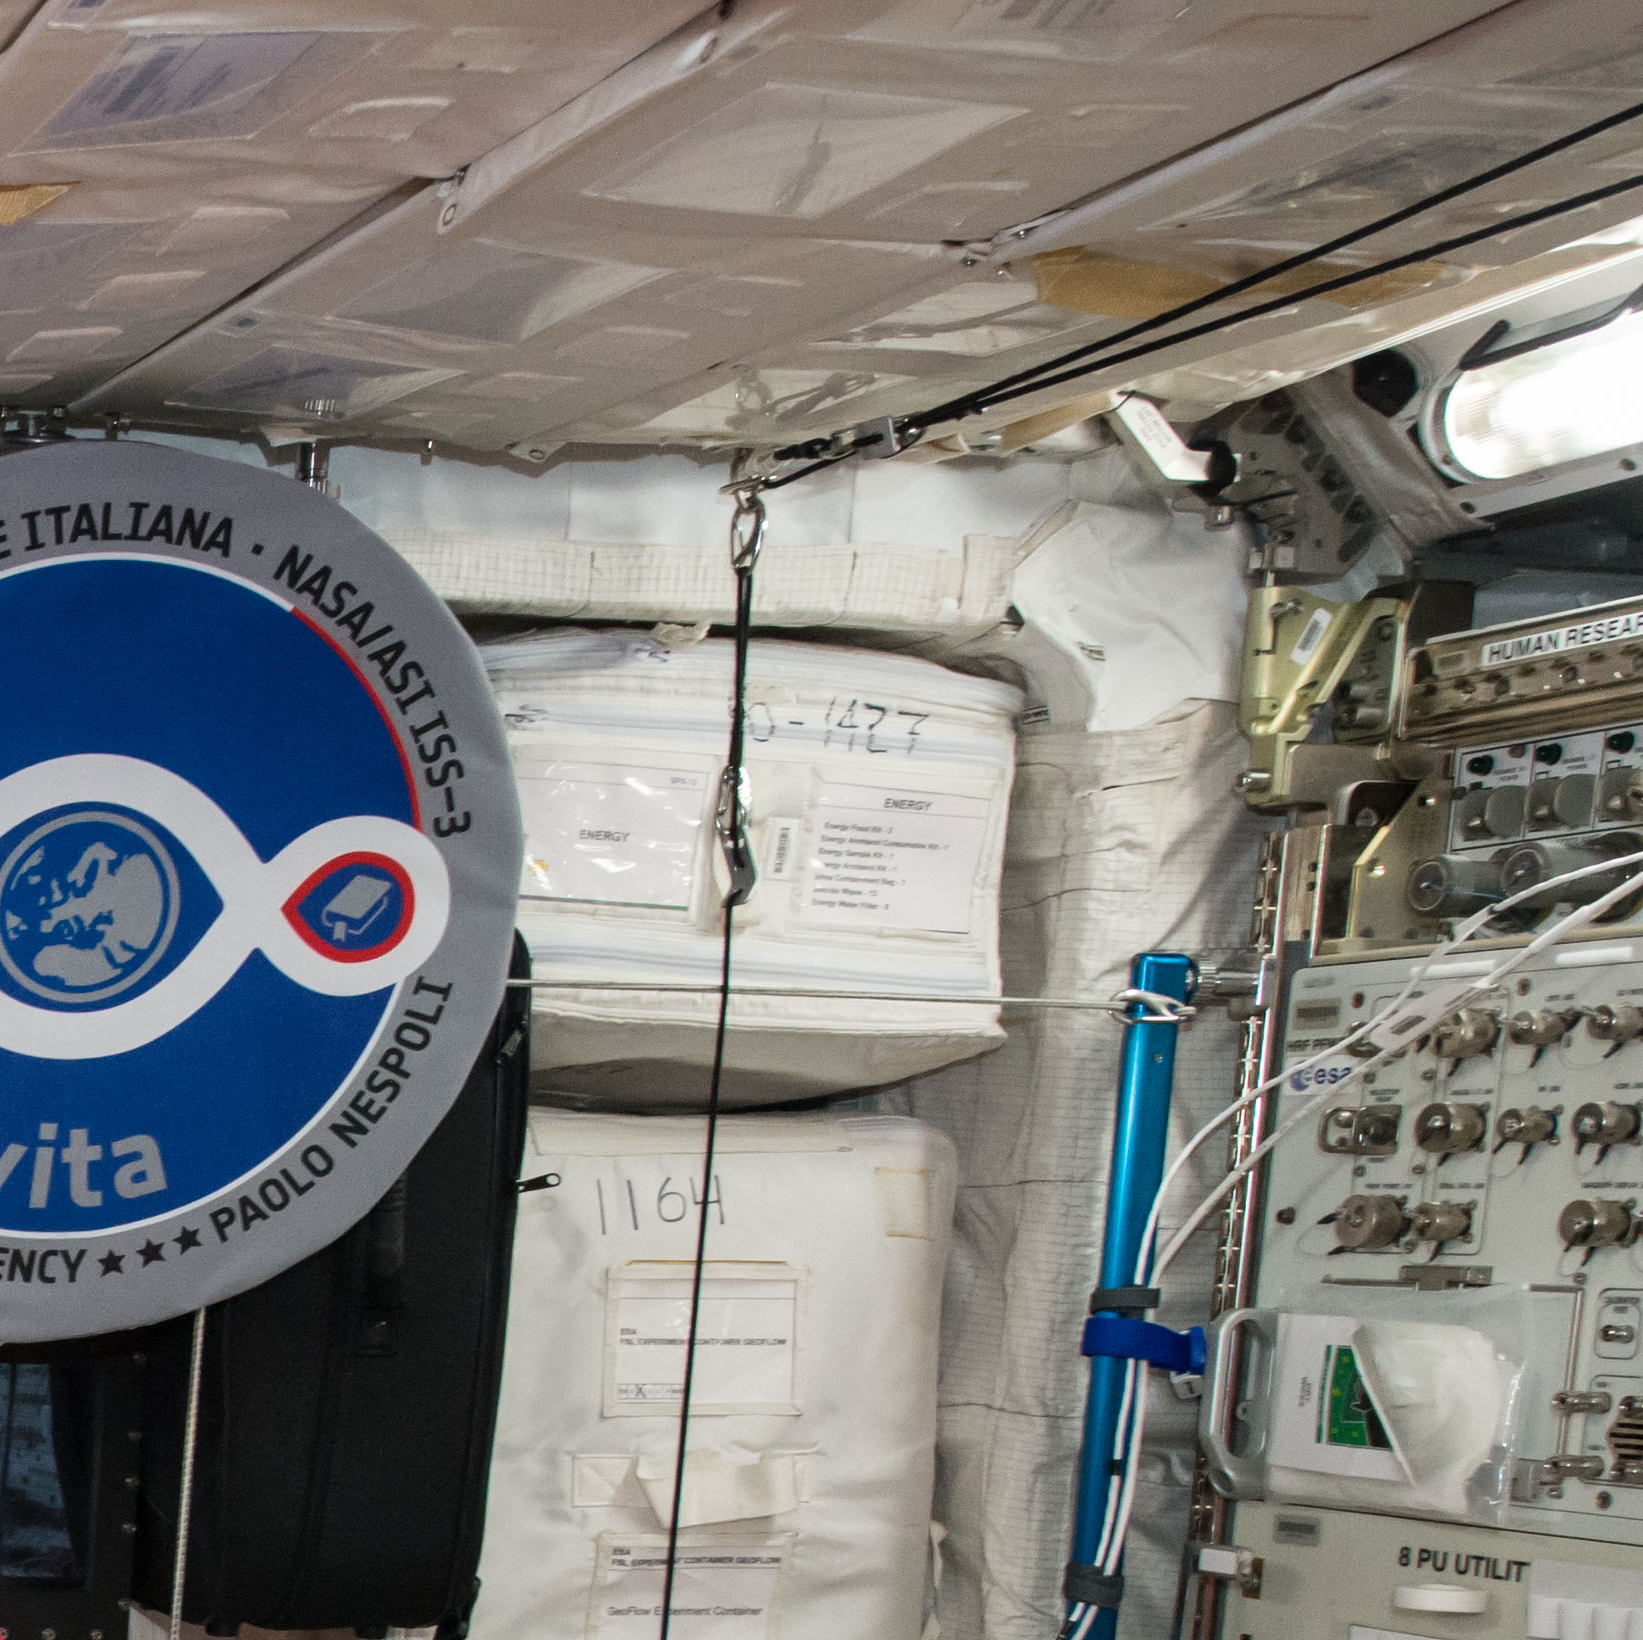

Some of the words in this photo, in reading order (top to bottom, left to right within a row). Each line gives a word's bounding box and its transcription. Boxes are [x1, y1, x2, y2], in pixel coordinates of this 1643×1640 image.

[21, 502, 232, 557] ITALIANA
[1488, 633, 1559, 665] HUMAN
[274, 544, 434, 709] NASA/ASI
[413, 708, 471, 839] ISS-3
[883, 798, 933, 811] ENERGY
[579, 828, 630, 844] ENERGY
[1314, 1066, 1352, 1085] esa
[210, 1144, 335, 1241] PAOLO
[329, 976, 454, 1138] NESPOLI
[597, 1175, 725, 1235] 1164
[1399, 1546, 1411, 1567] 8
[1417, 1548, 1448, 1572] PU
[1455, 1553, 1531, 1583] UTILIT
[653, 1607, 712, 1616] Eeriment
